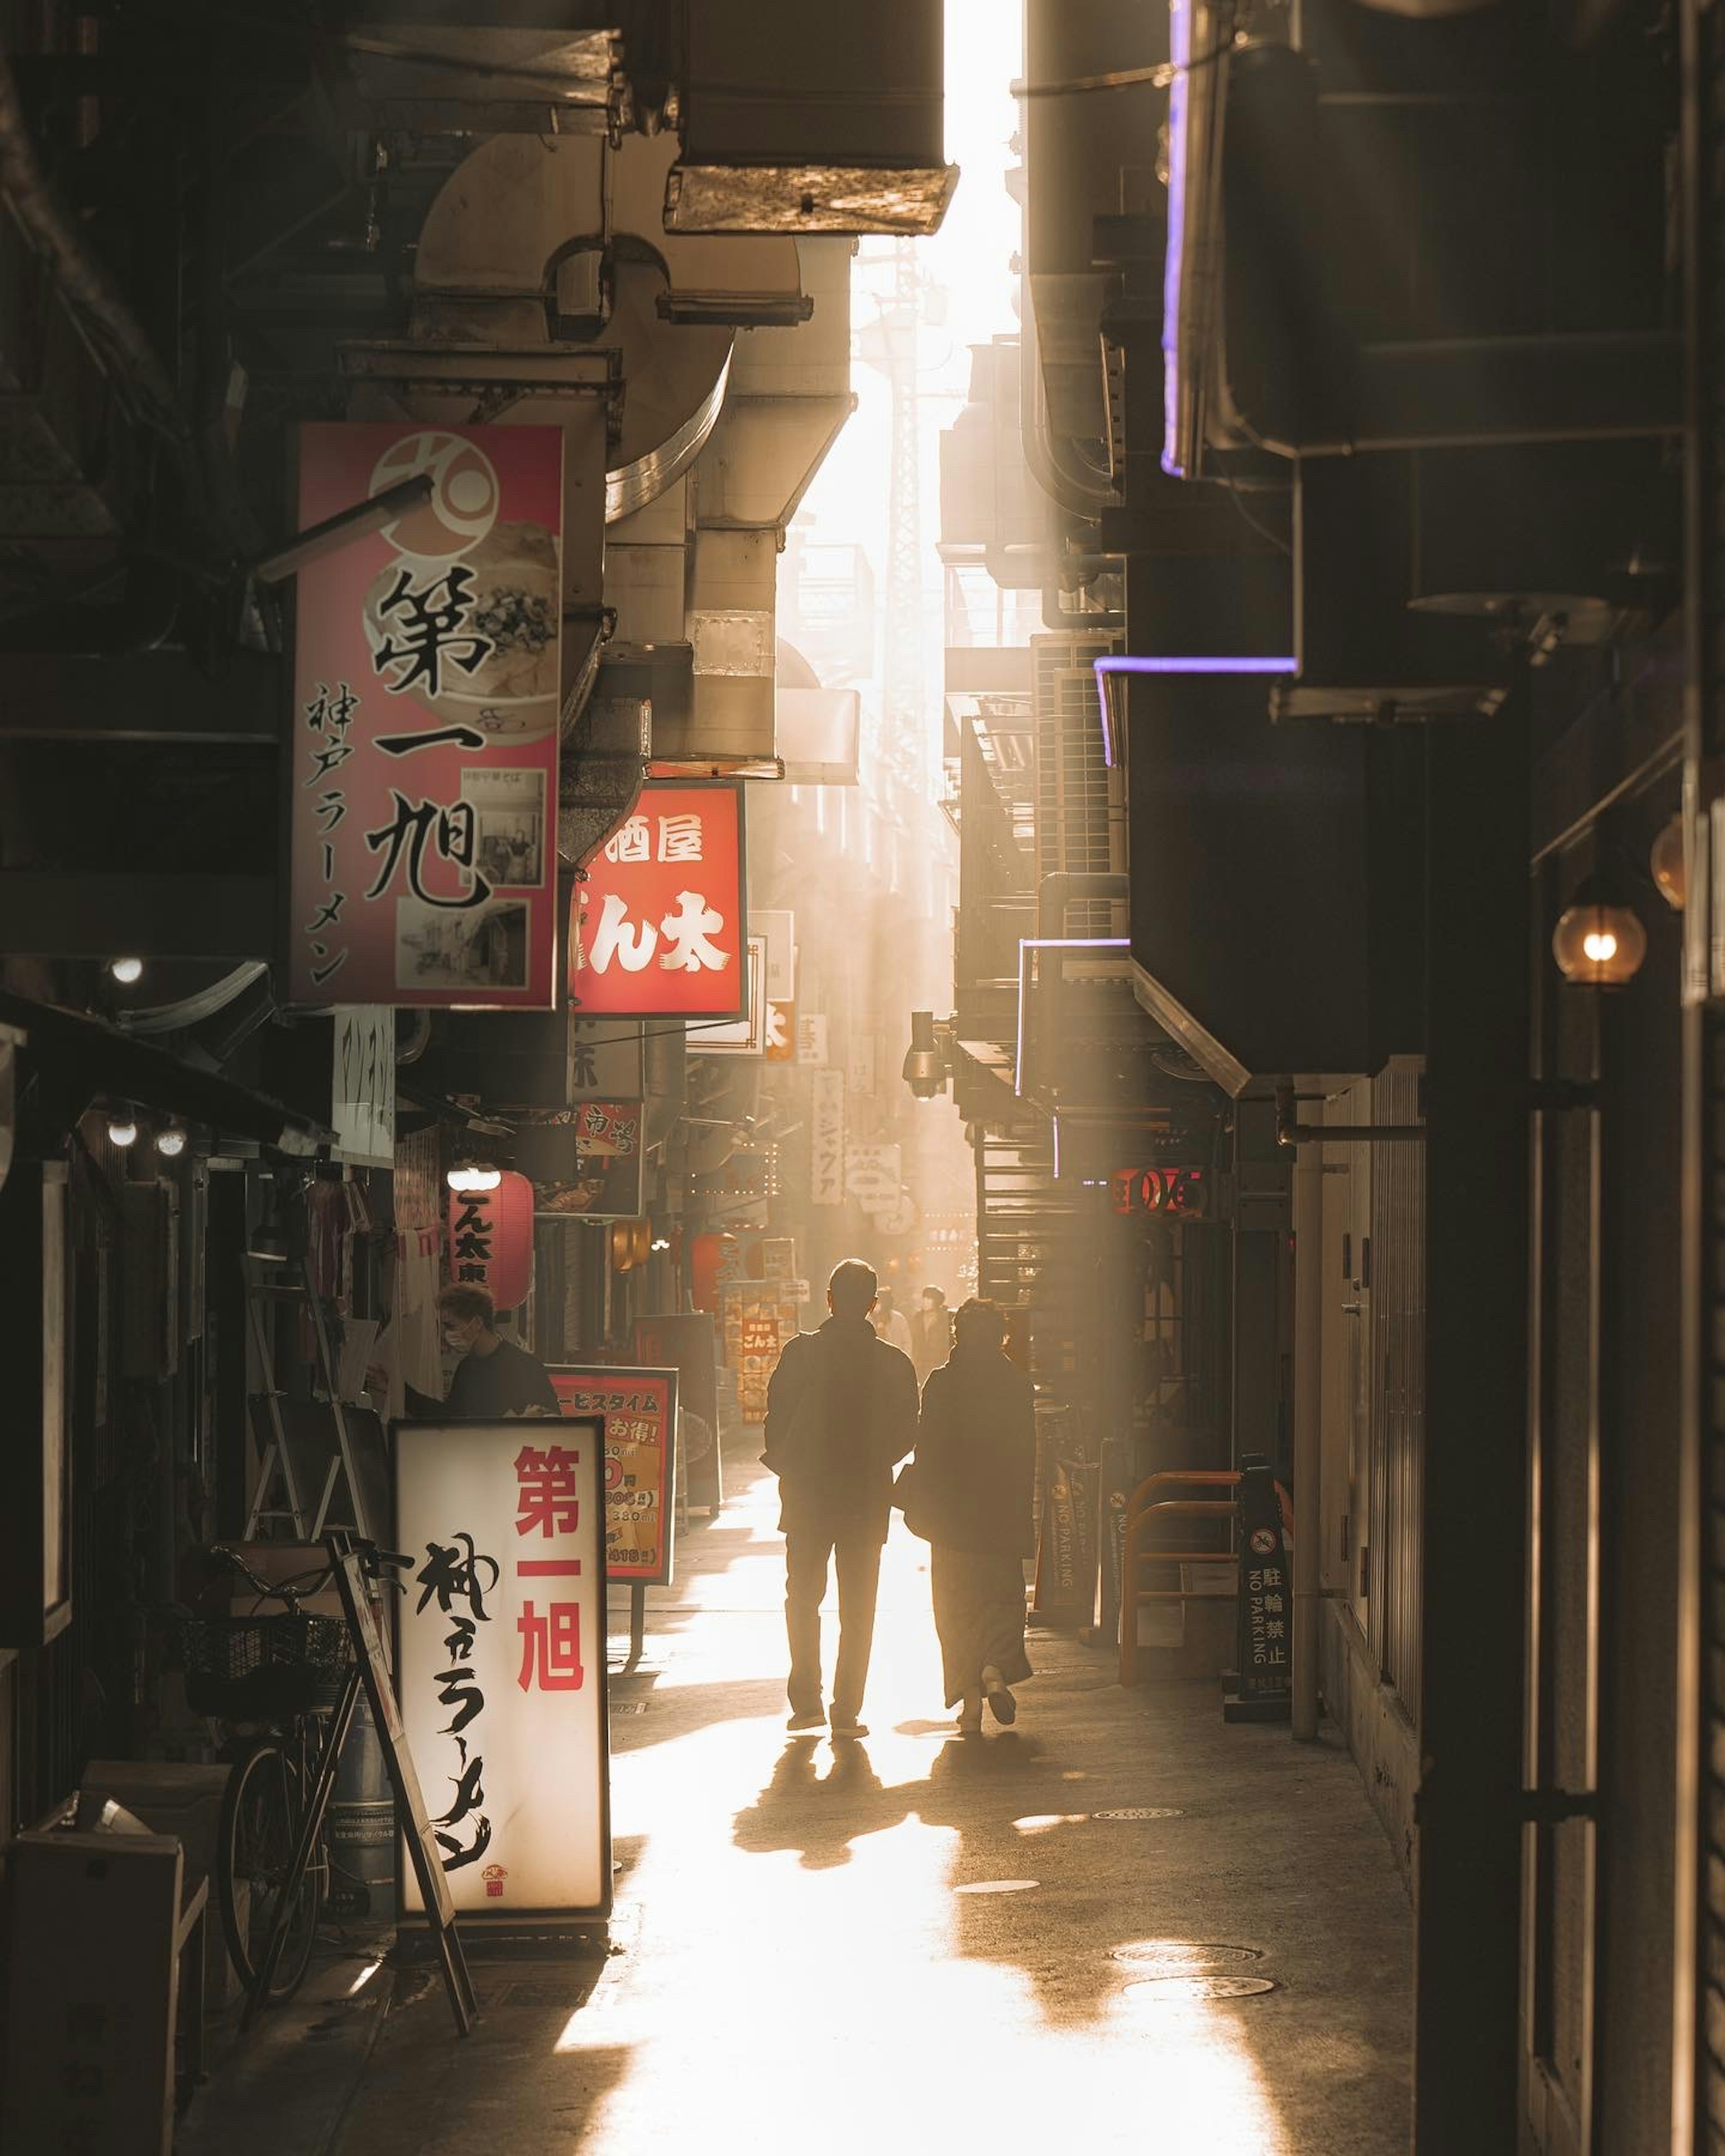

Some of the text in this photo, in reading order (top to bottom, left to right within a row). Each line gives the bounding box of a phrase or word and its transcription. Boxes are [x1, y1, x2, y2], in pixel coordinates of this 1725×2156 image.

[366, 566, 492, 907] 第一旭
[306, 684, 358, 983] 神戸ラーメン
[593, 814, 703, 862] 酒屋
[575, 891, 732, 974] ん太
[514, 1445, 584, 1693] 第一旭
[1058, 1505, 1073, 1590] NO PARKING
[1248, 1570, 1267, 1664] NO PARKING
[1263, 1567, 1287, 1665] 駐輪禁止
